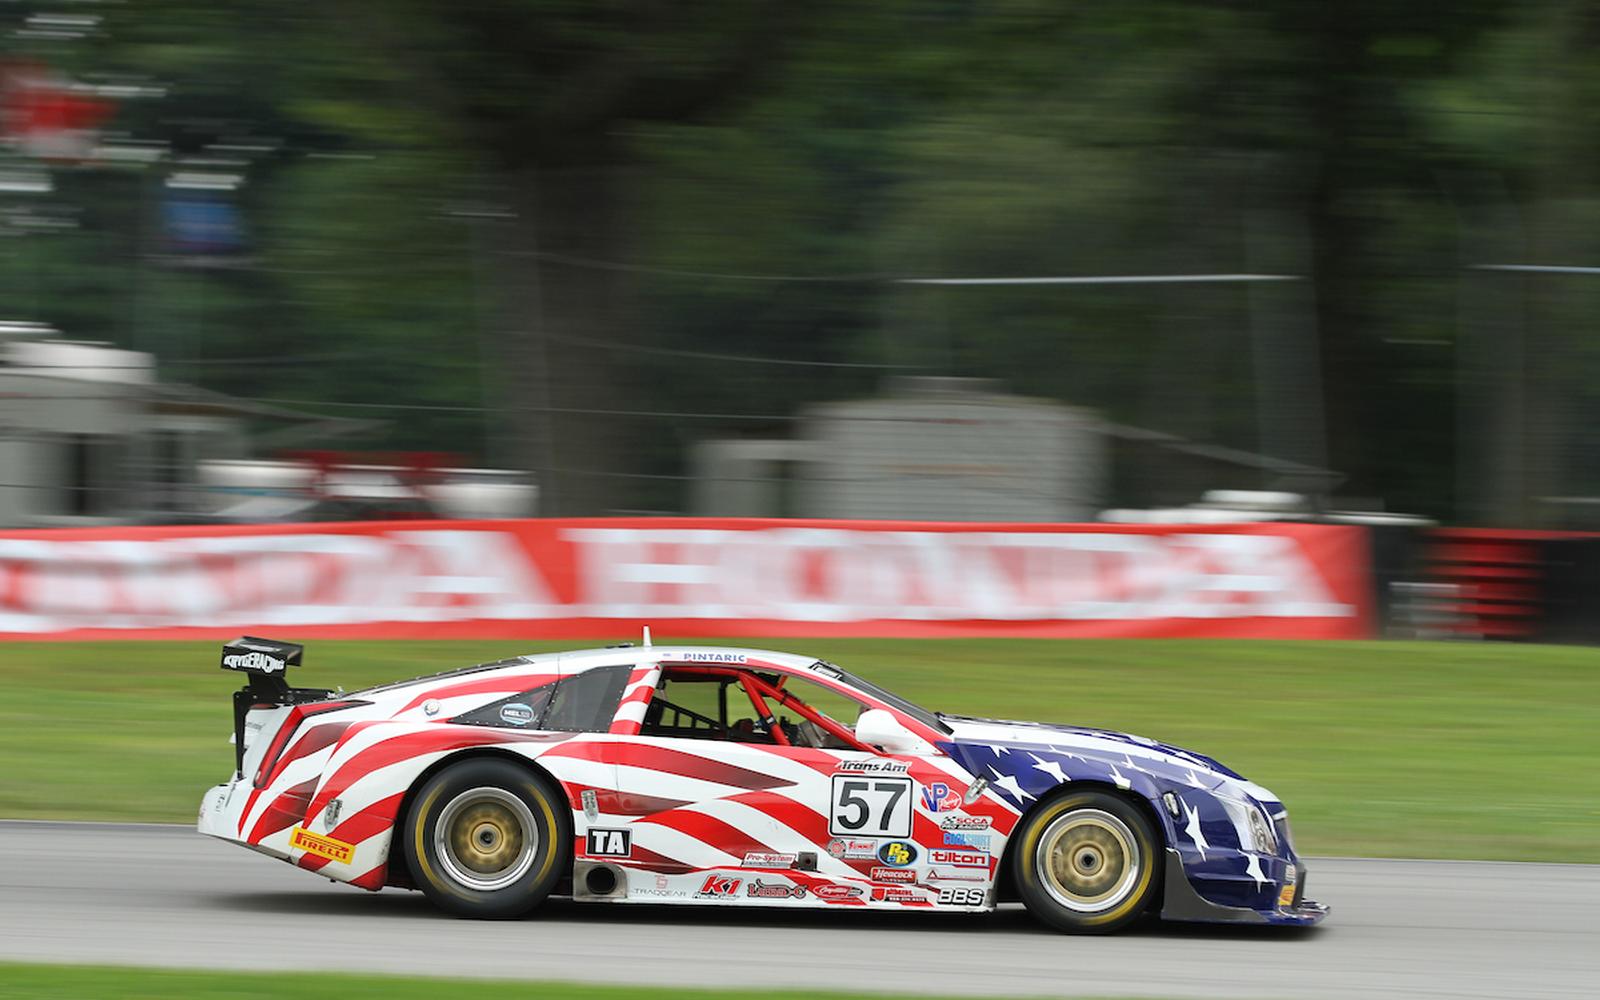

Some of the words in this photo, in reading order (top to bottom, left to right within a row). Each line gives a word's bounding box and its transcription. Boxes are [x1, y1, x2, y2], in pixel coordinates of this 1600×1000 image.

[683, 652, 746, 662] PINTARIC
[841, 760, 880, 771] Trans
[881, 762, 907, 772] Am
[837, 781, 907, 831] 57
[921, 783, 949, 812] VP
[956, 817, 989, 825] SCCA
[294, 832, 350, 859] PIRELLI
[592, 831, 625, 854] TA
[932, 851, 986, 865] tilton
[700, 874, 743, 895] K1
[937, 887, 985, 906] BBS
